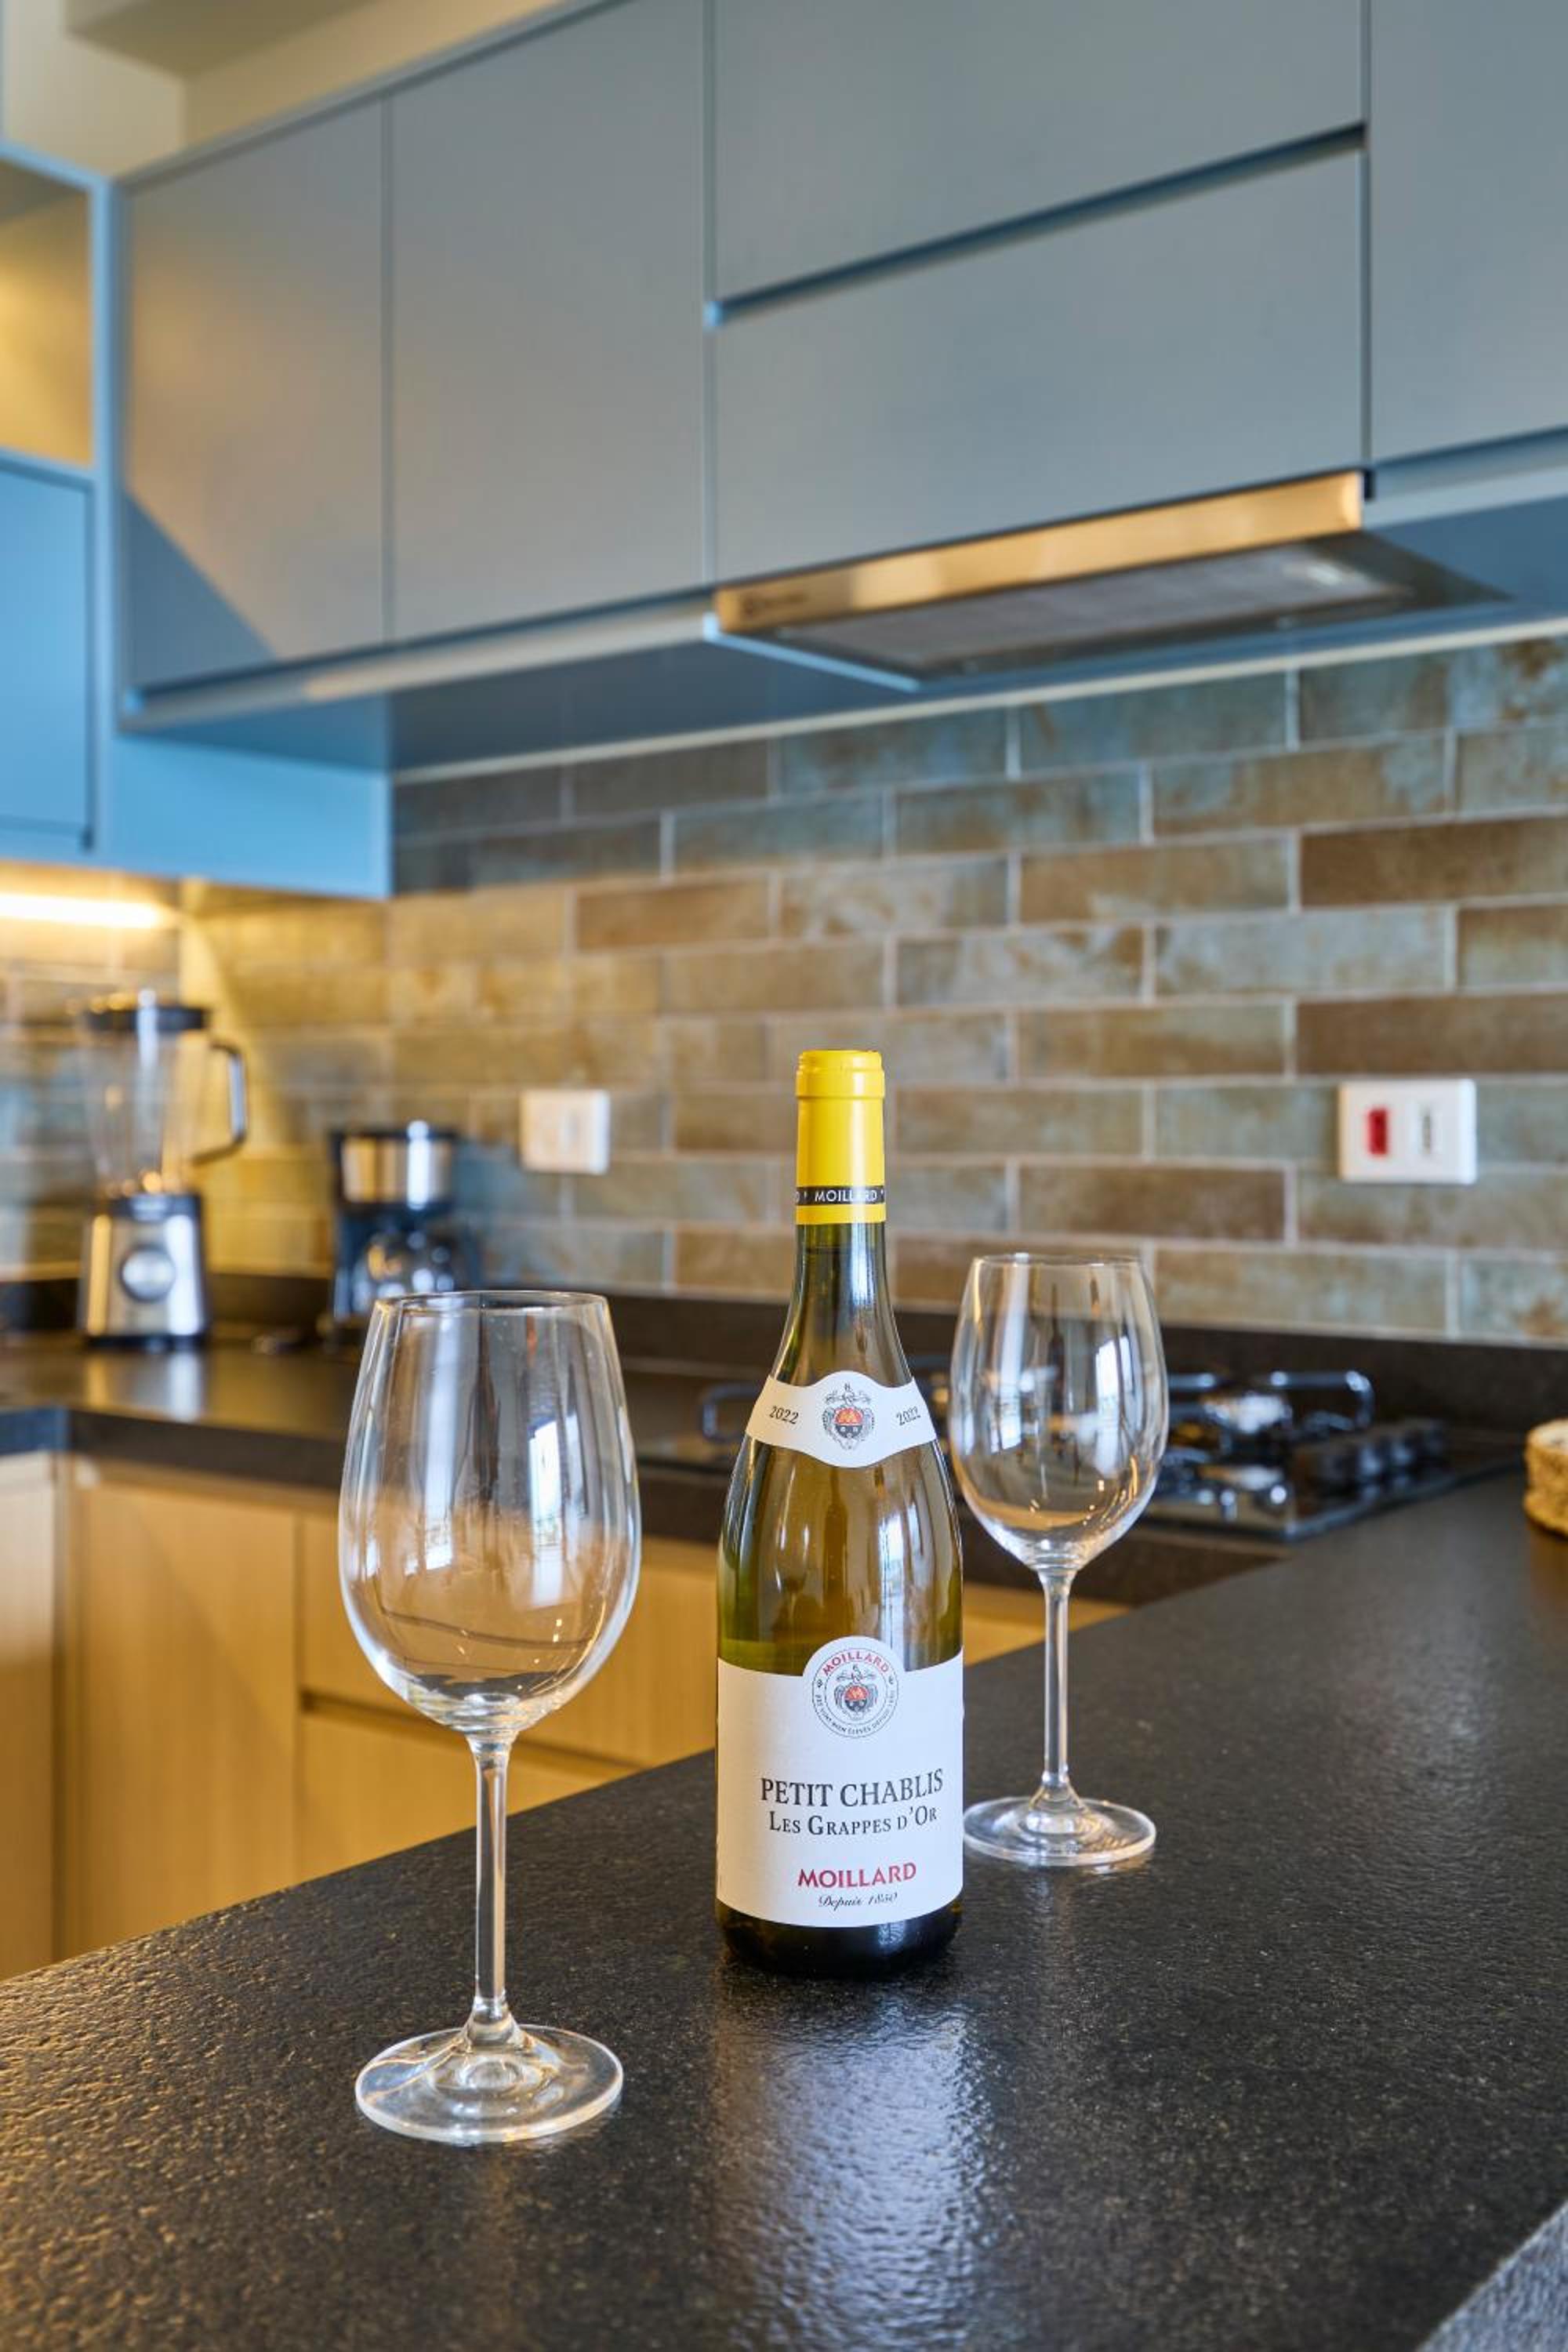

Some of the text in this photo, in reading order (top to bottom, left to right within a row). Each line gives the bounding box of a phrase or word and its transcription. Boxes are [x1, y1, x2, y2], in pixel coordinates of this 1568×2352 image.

[769, 1406, 921, 1426] 2022 2022
[822, 1651, 889, 1675] MOILLARD
[760, 1768, 944, 1807] PETIT CHABLIS
[797, 1861, 917, 1889] MOILLARD
[818, 1893, 863, 1911] Depuis
